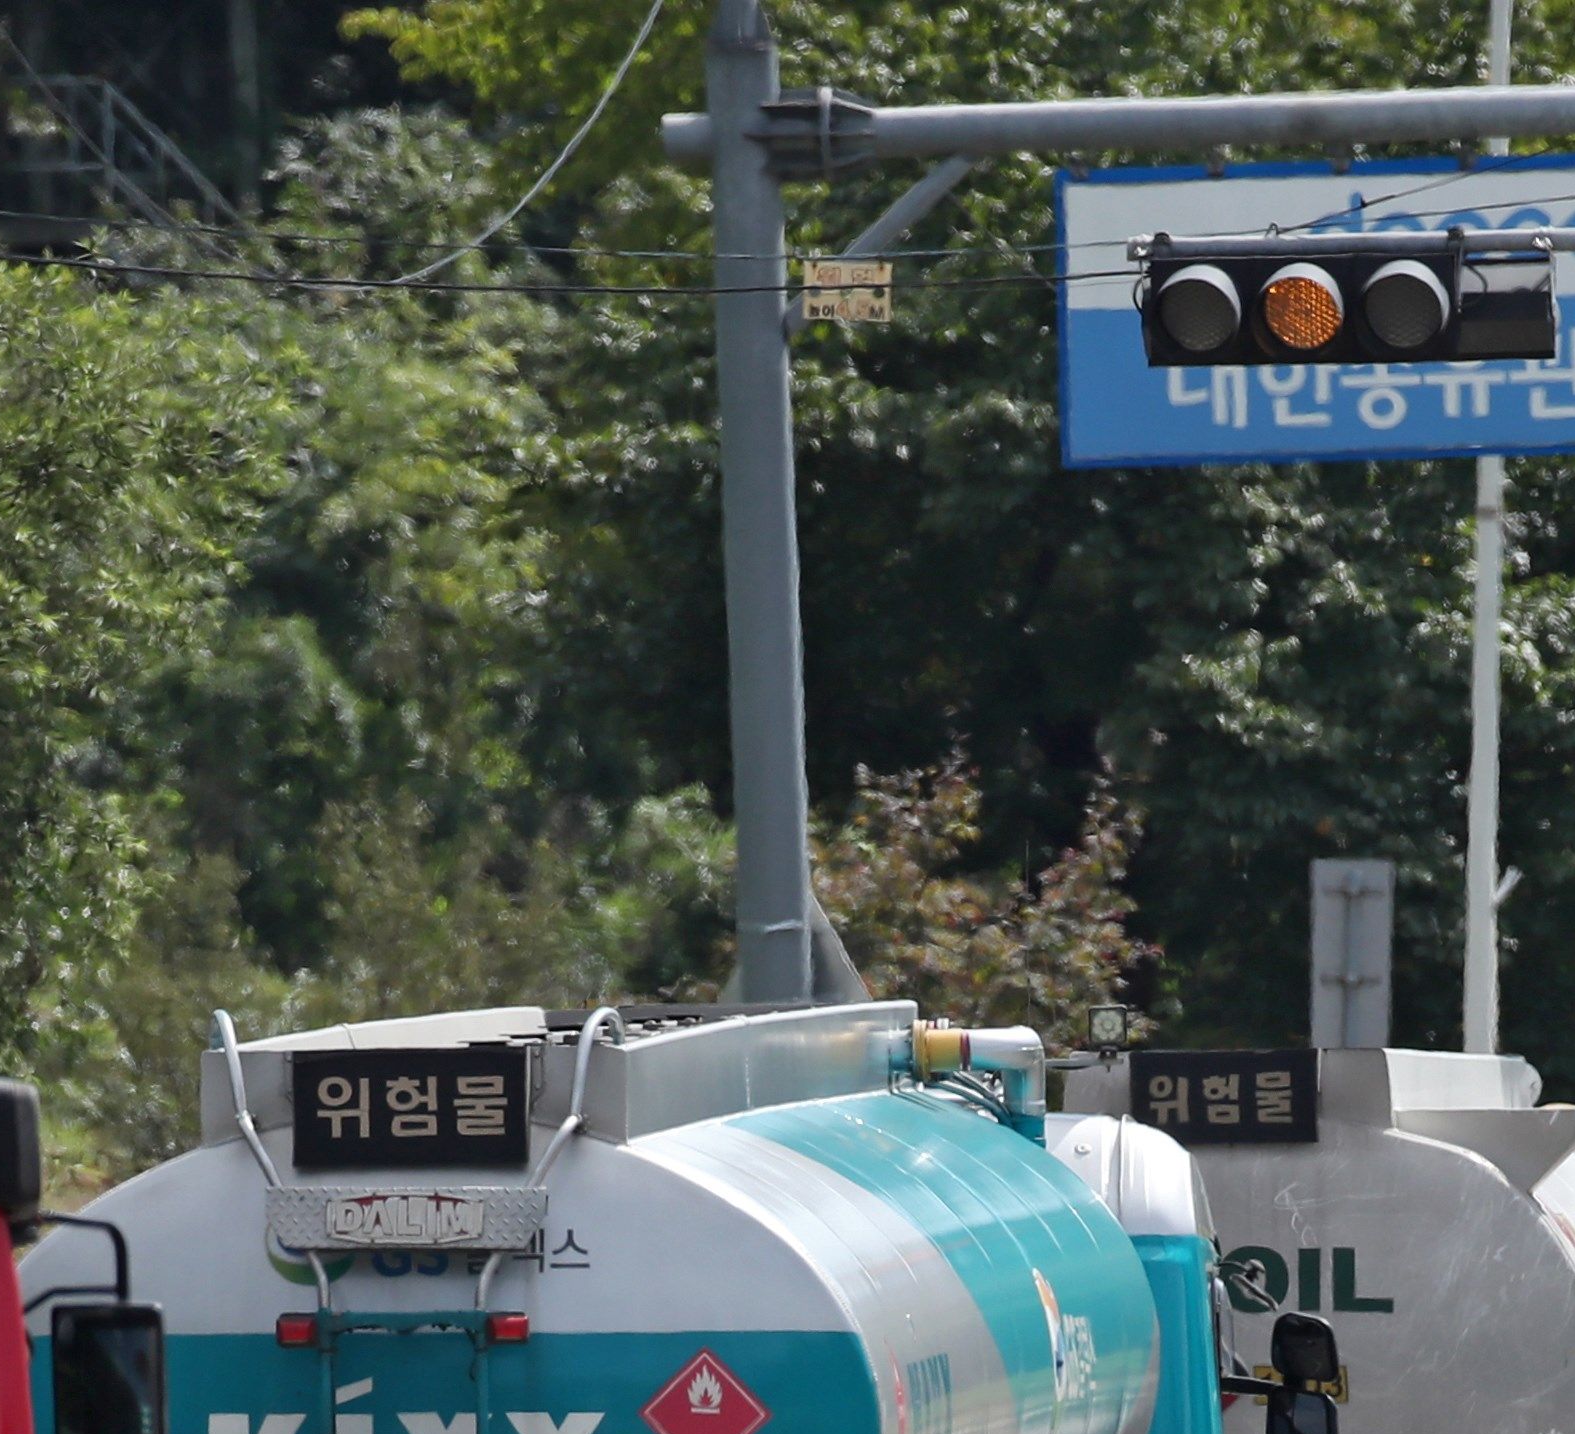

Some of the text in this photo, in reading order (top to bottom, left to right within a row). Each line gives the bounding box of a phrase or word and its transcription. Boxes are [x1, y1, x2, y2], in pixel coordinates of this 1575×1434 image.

[316, 1075, 509, 1139] 위험물
[1147, 1071, 1295, 1126] 위험물
[335, 1196, 476, 1237] DALIM
